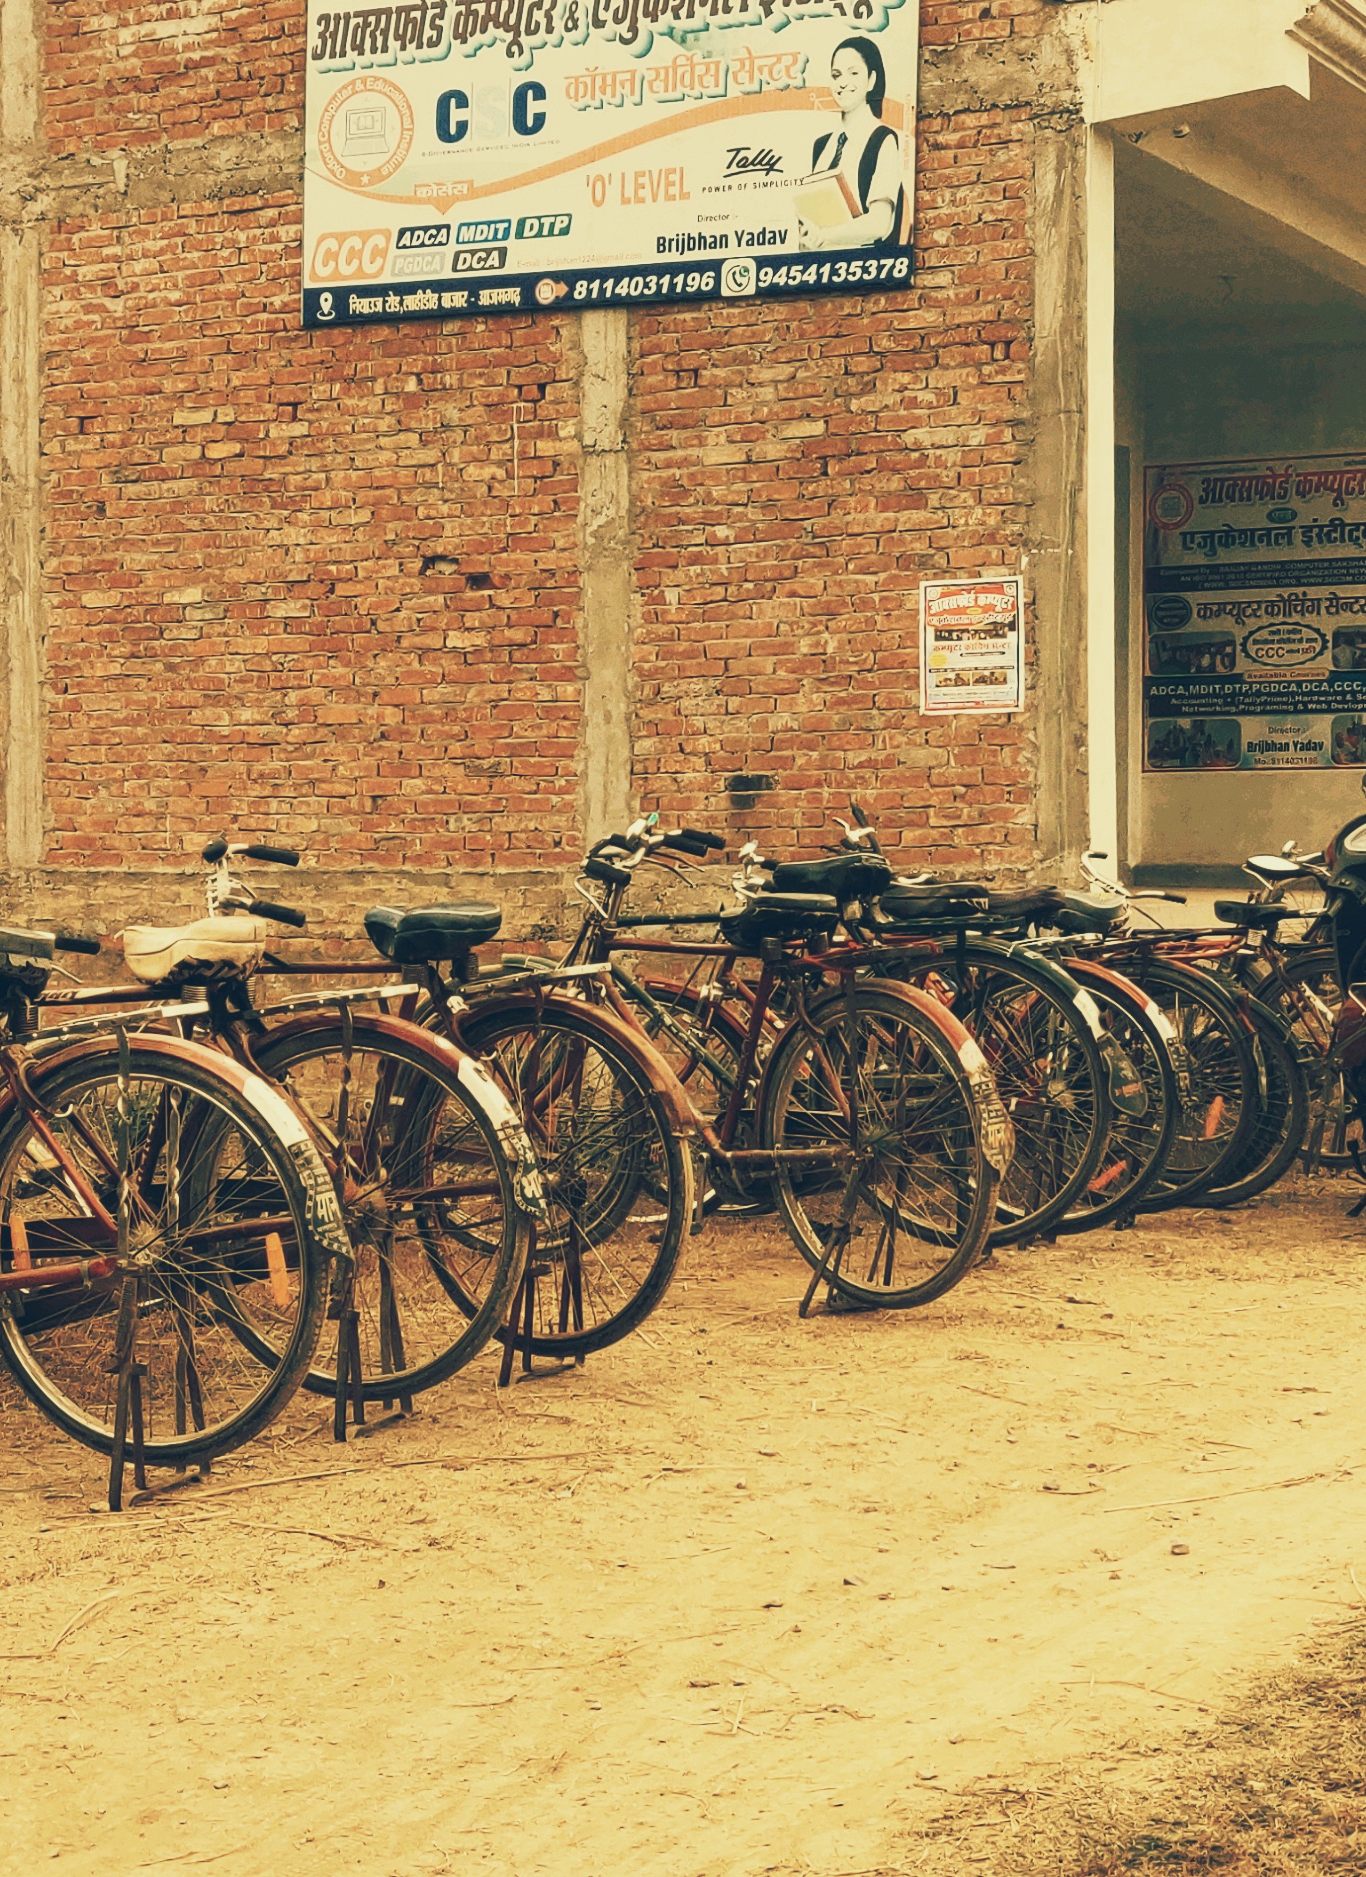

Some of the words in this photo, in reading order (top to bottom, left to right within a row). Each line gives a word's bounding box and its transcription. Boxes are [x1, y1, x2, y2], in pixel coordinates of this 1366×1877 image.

[563, 0, 580, 33] &
[355, 79, 365, 92] &
[564, 66, 637, 102] कॉमन
[646, 52, 722, 94] सर्विस
[731, 45, 802, 86] सेन्टर
[319, 84, 354, 142] Computer
[366, 77, 413, 129] Educational
[319, 143, 346, 179] Oxford
[380, 130, 413, 176] Institute
[724, 146, 784, 177] Tally
[620, 166, 691, 206] LEVEL
[701, 184, 733, 194] POWER
[737, 182, 747, 191] OF
[752, 178, 805, 190] SIMPLICITY
[458, 221, 510, 243] MDIT
[523, 217, 571, 238] DTP
[697, 213, 730, 223] Director
[398, 227, 448, 248] ADCA
[656, 230, 729, 256] Brijbhan
[734, 226, 789, 250] Yadav
[312, 233, 387, 278] CCC
[393, 253, 443, 274] PGDCA
[456, 250, 501, 271] DCA
[572, 271, 715, 301] 8114031196
[758, 257, 909, 288] 9454135378
[440, 290, 469, 309] बाजार
[1198, 464, 1293, 505] आक्सफोर्ड
[1179, 522, 1296, 557] एजुकेशनल
[1288, 568, 1347, 578] ORGANIZATION
[1349, 567, 1366, 575] NEW
[1196, 600, 1262, 626] कम्प्यूटर
[1264, 591, 1323, 619] कोचिंग
[1255, 646, 1285, 659] CCC
[1307, 702, 1328, 710] Web
[1268, 726, 1301, 735] Director
[1246, 739, 1290, 754] Brijbhan
[1292, 739, 1325, 753] Yadav
